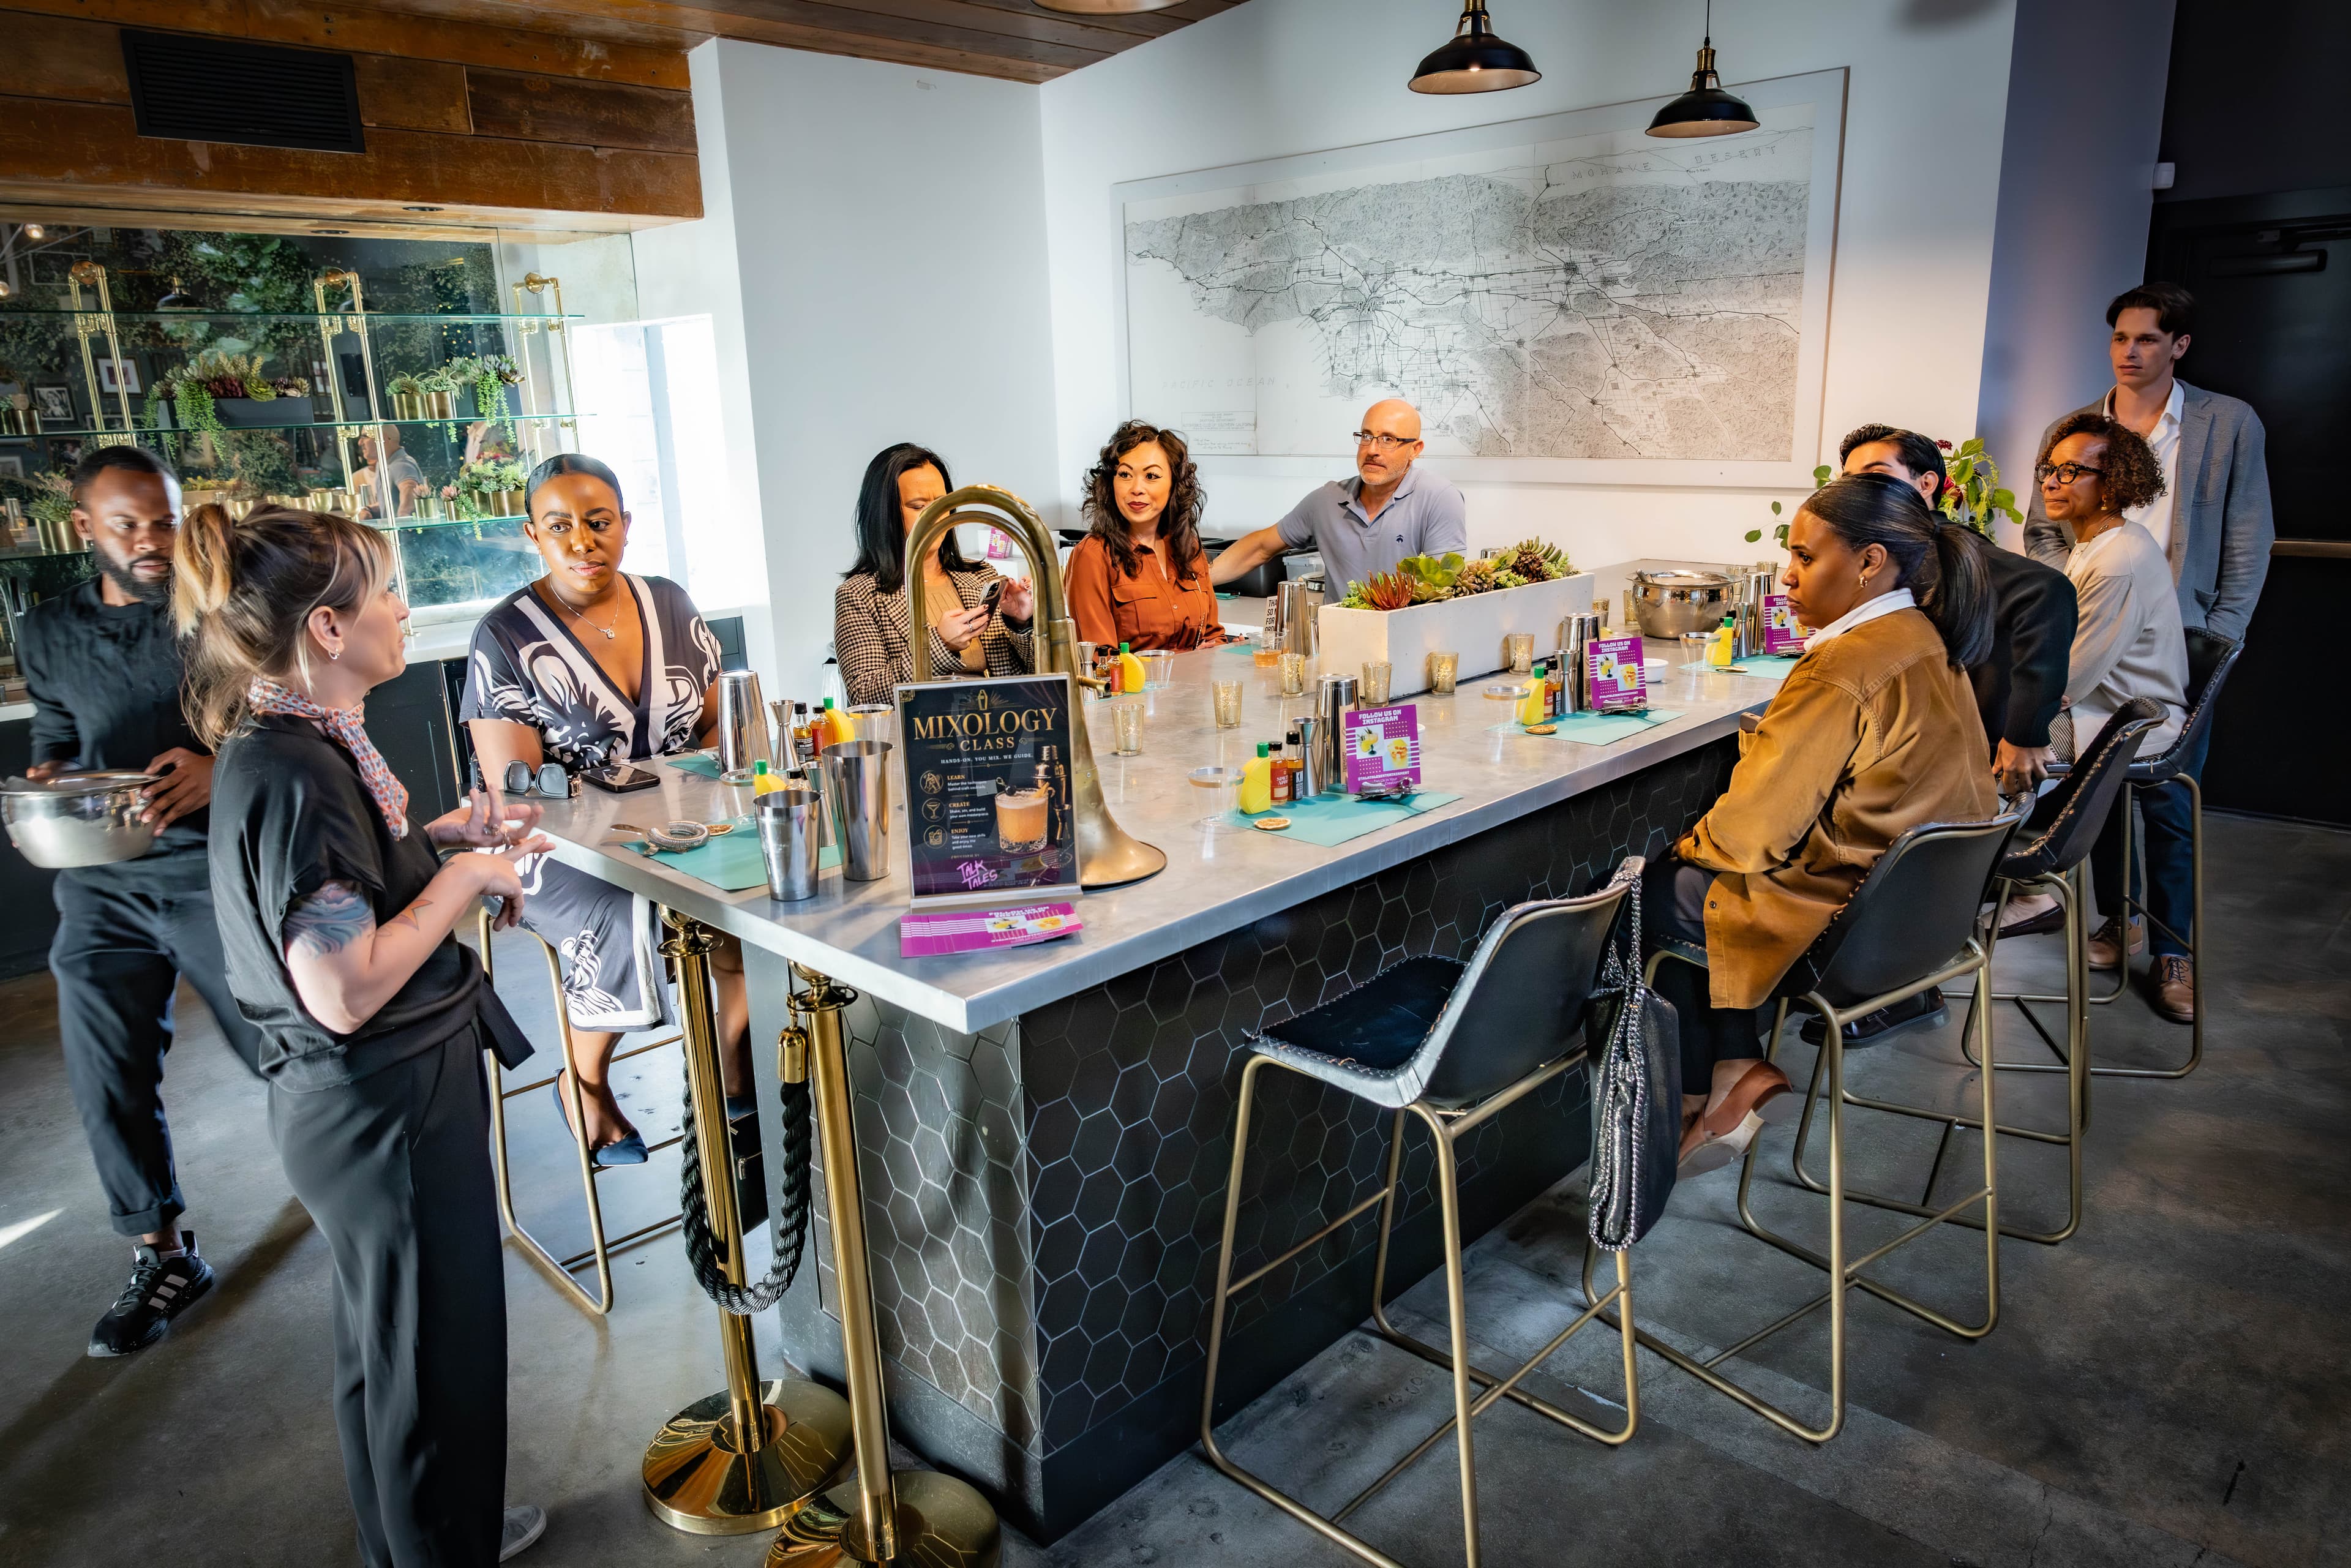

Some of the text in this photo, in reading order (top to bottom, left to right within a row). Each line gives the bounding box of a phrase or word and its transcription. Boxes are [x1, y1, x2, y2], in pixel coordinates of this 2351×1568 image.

[1572, 145, 1776, 180] MOHAVE DESERT
[1161, 377, 1275, 391] PACIFIC OCEAN
[912, 707, 1057, 740] MIXOLOGY
[1359, 711, 1383, 720] FOLLOW
[1362, 715, 1398, 725] INSTAGRAM
[959, 737, 1014, 751] CLASS
[956, 860, 988, 882] TALK
[961, 869, 998, 890] TALES
